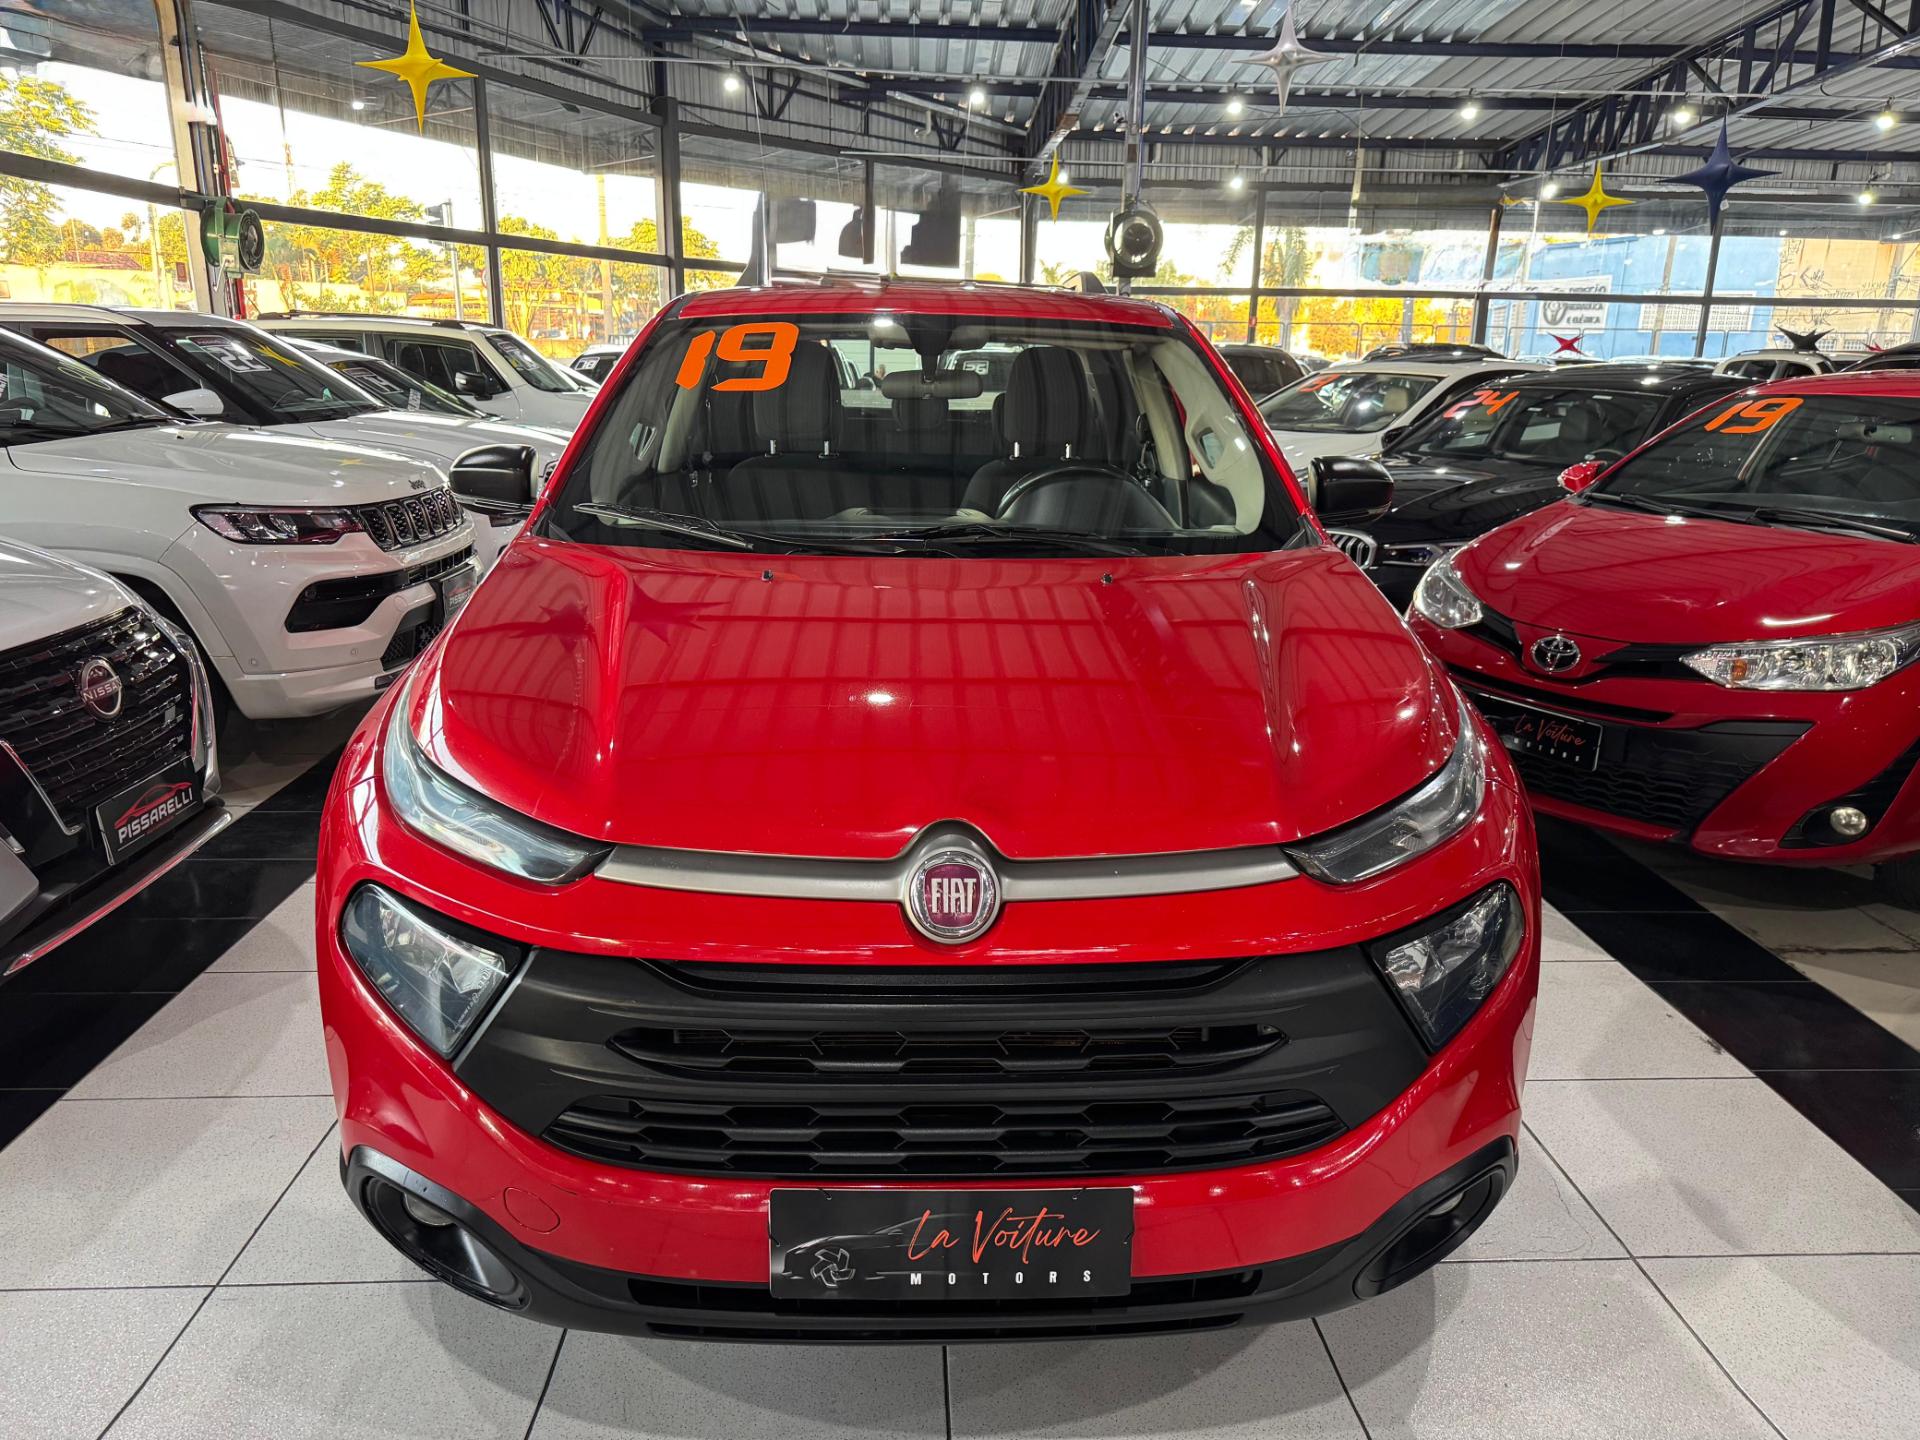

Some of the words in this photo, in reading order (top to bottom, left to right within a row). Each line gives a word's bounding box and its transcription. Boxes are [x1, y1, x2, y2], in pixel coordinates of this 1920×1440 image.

[675, 321, 799, 391] 19
[1443, 389, 1520, 419] 24
[1704, 397, 1804, 434] 19
[1537, 719, 1586, 748] Voiture
[118, 787, 193, 844] PISSARELLI
[931, 877, 976, 914] FIAT
[908, 1208, 960, 1261] La
[972, 1206, 1101, 1265] Voiture
[910, 1269, 1091, 1285] MOTORS
